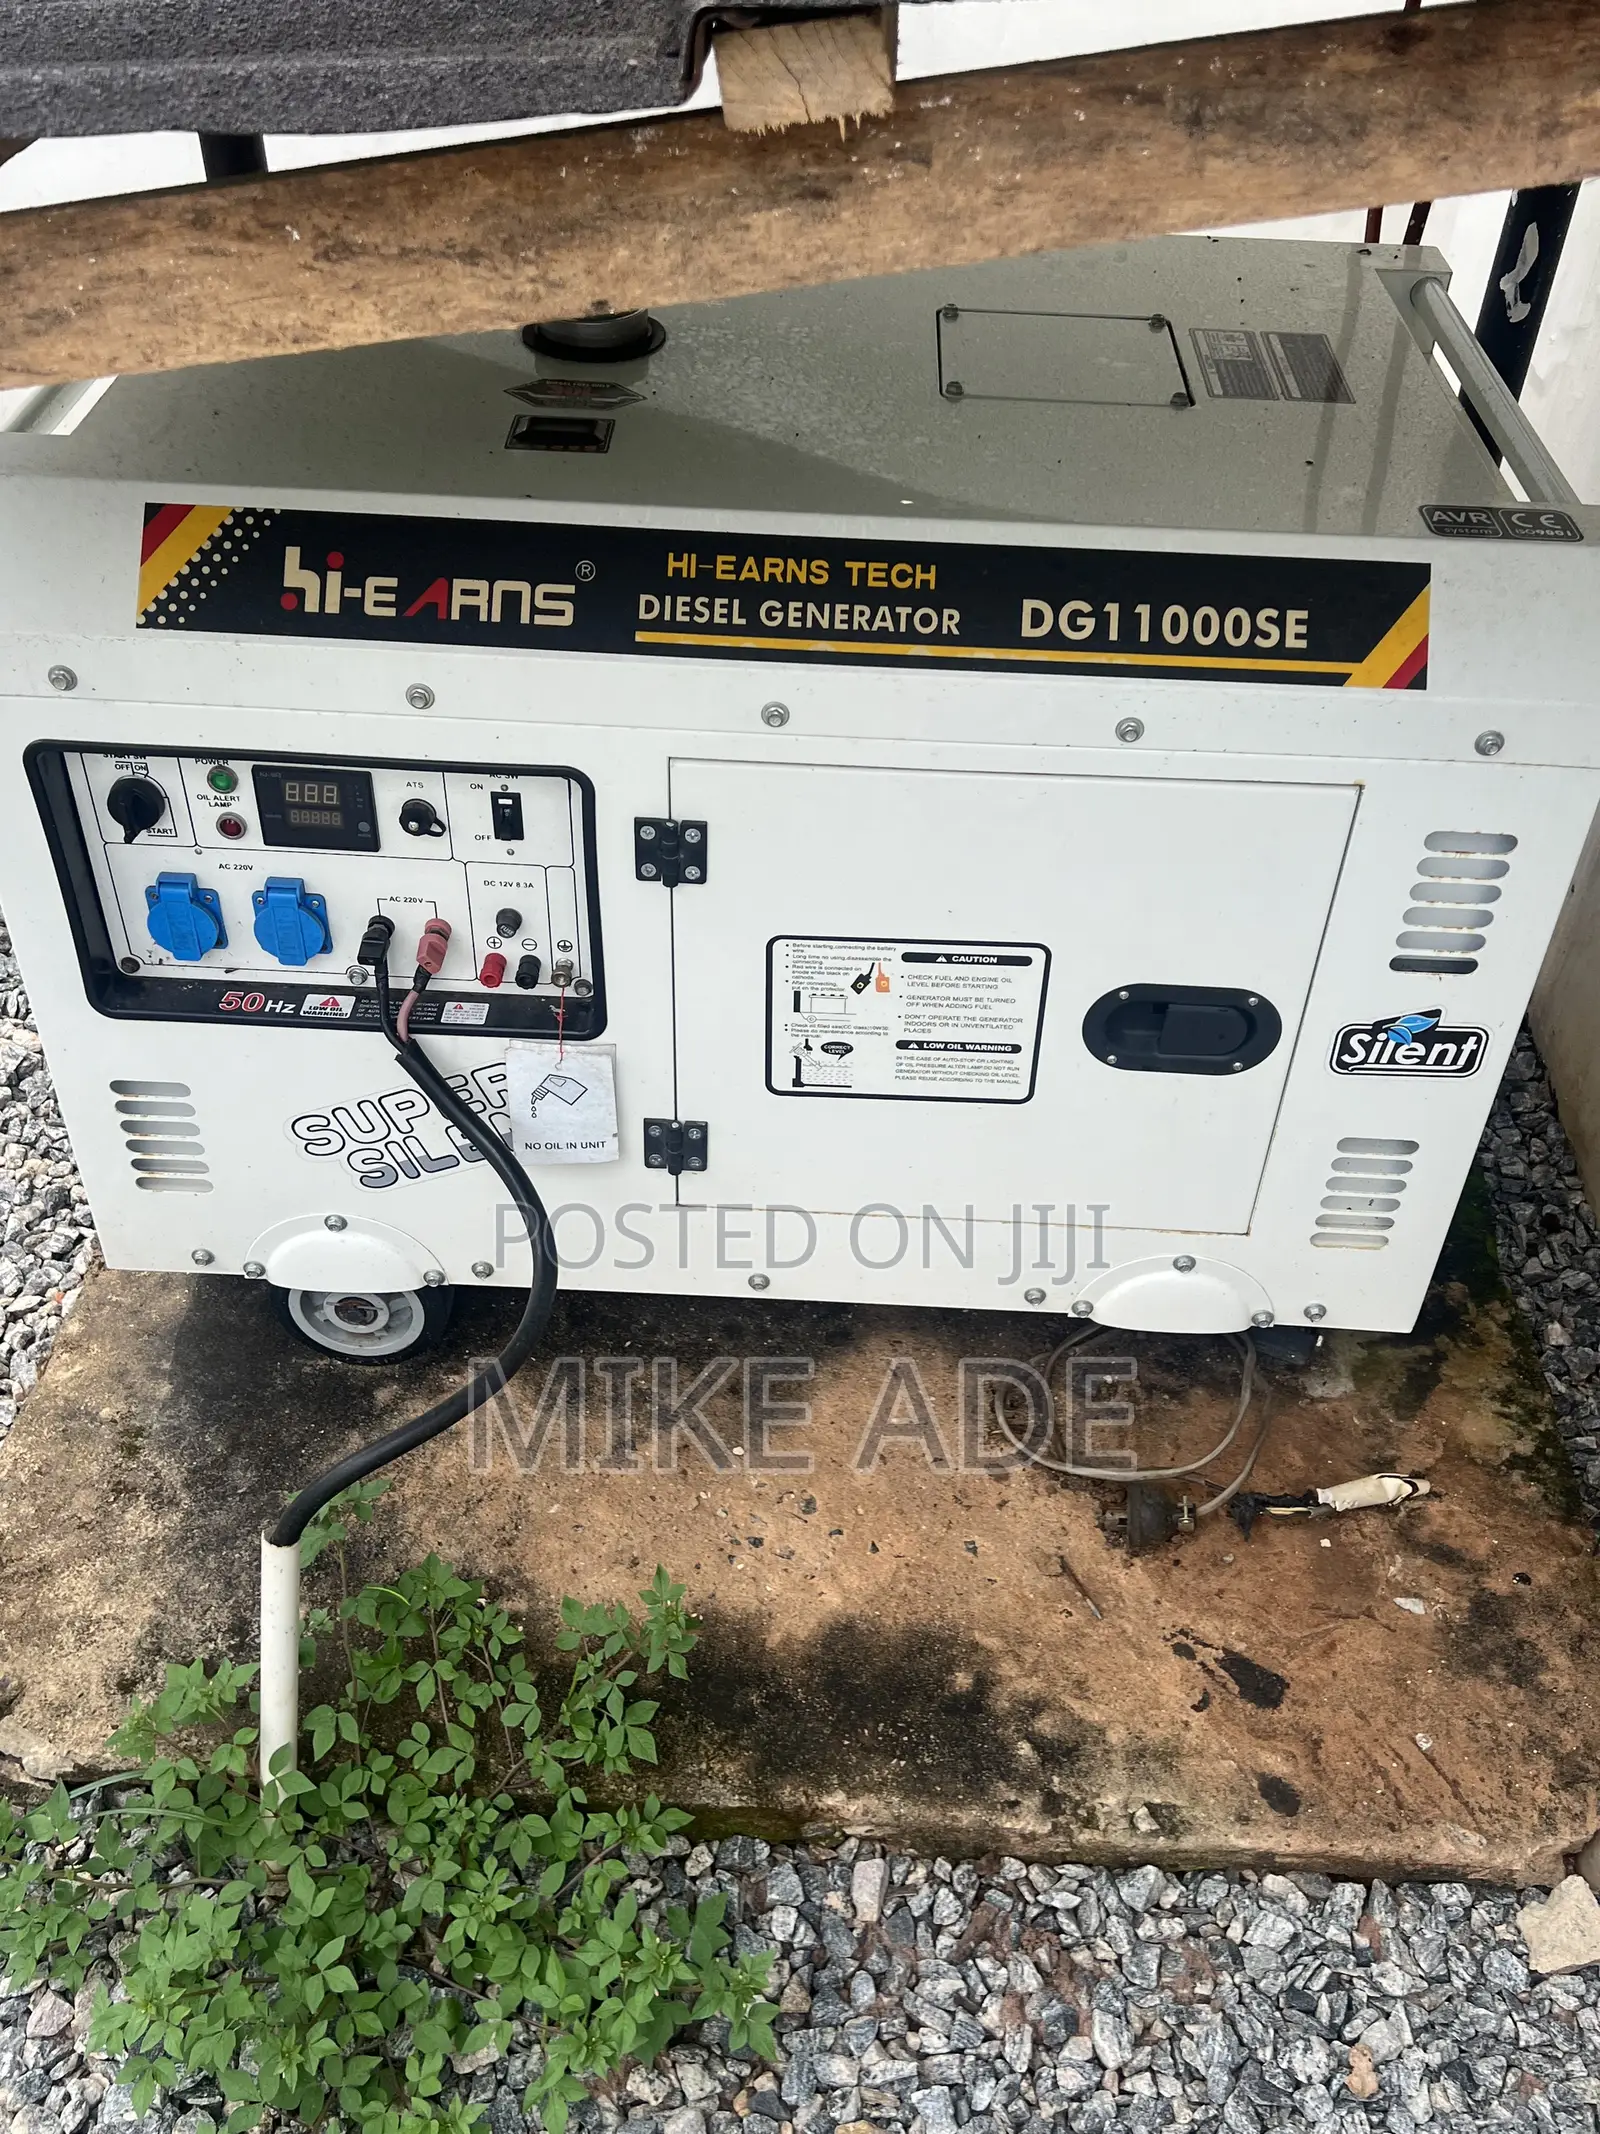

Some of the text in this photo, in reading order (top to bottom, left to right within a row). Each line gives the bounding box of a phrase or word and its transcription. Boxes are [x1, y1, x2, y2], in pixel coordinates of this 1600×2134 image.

[1432, 511, 1492, 524] AVR
[1515, 528, 1572, 536] ISO9001
[667, 552, 937, 590] HI-EARNS TECH
[638, 593, 962, 636] DIESEL GENERATOR
[1021, 598, 1310, 650] DG11000SE
[500, 925, 515, 935] FUSE
[952, 956, 997, 964] CAUTION
[1340, 1032, 1477, 1065] Silent
[524, 1142, 541, 1150] NO
[544, 1142, 564, 1150] OIL
[580, 1140, 606, 1149] UNIT
